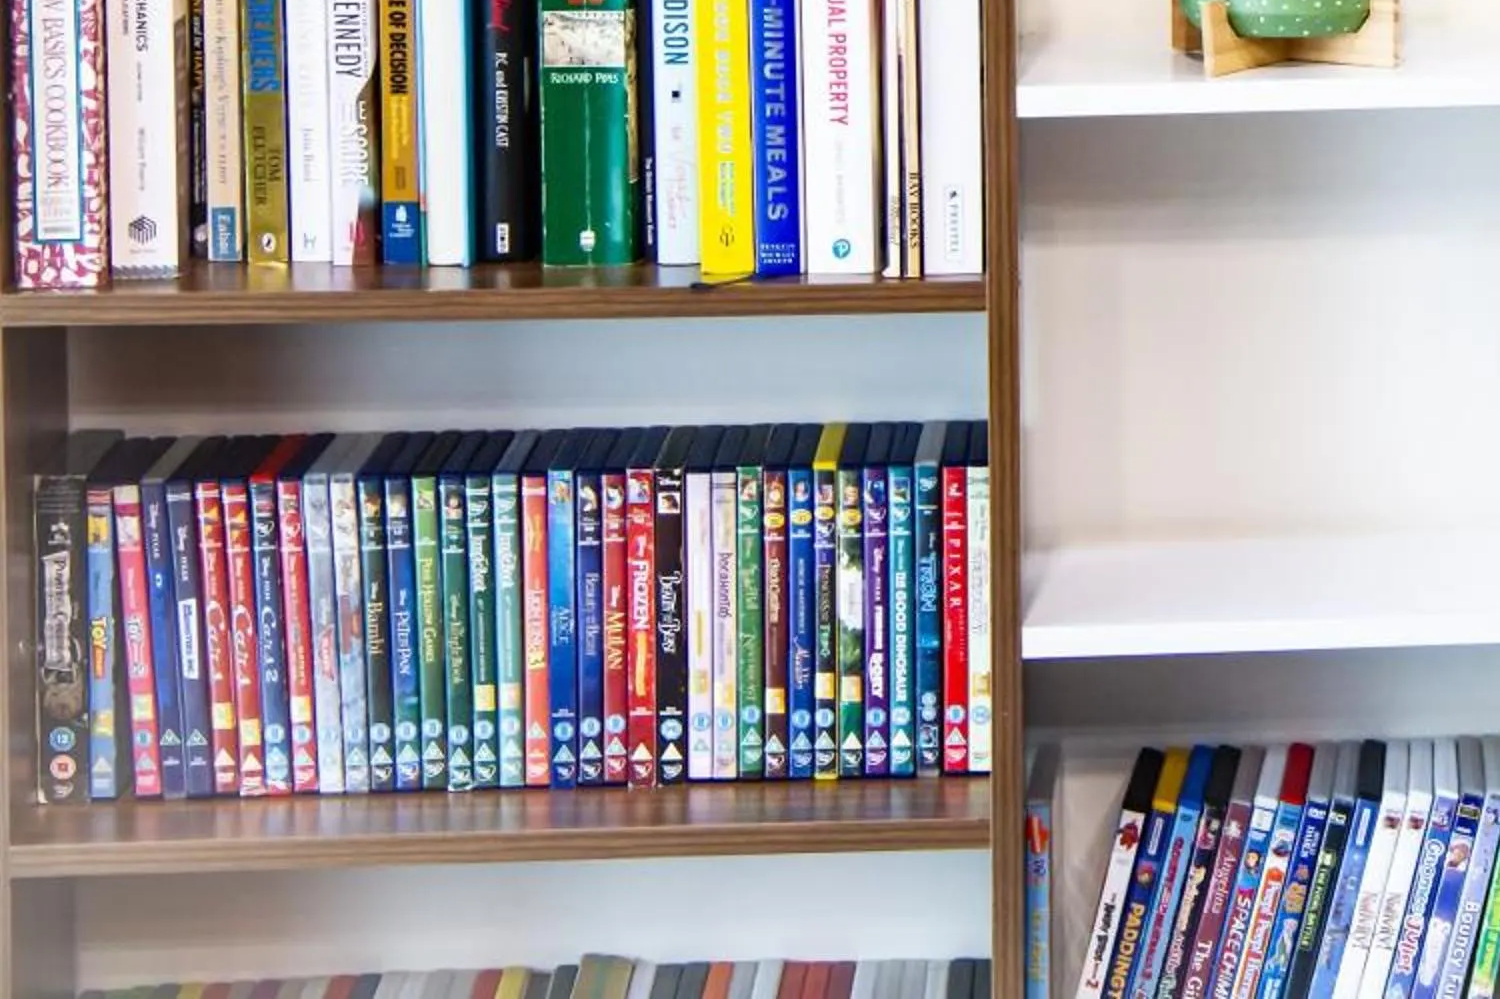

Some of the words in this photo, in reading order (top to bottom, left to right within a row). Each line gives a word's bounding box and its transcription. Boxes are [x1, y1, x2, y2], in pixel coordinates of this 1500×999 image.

[43, 17, 67, 80] BASICS
[388, 11, 408, 29] OF
[389, 32, 409, 95] DECISION
[495, 70, 509, 88] and
[550, 71, 593, 85] RICHARD
[714, 49, 732, 101] BOOK
[827, 33, 849, 126] PROPERTY
[44, 83, 71, 190] COOKBOOK
[251, 125, 268, 206] FLETCHER
[266, 147, 281, 182] TOM
[339, 123, 369, 186] SCORE
[495, 124, 510, 149] CAST
[764, 124, 789, 222] MEALS
[631, 559, 650, 630] FROZEN
[716, 551, 734, 619] POCAHONTAS
[948, 538, 963, 609] PIXAR
[91, 616, 108, 649] TOY
[260, 604, 277, 667] Cars
[367, 601, 384, 655] Bambi
[395, 610, 411, 648] PETER
[895, 589, 907, 632] GOOD
[207, 601, 226, 682] Cars
[231, 604, 253, 687] Cars
[396, 648, 412, 676] PAN
[423, 626, 437, 663] GAMES
[606, 610, 626, 670] MULAN
[895, 633, 907, 702] DINOSAUR
[264, 668, 279, 683] 2
[868, 651, 884, 699] DORY
[1226, 894, 1251, 951] SPACE
[1450, 899, 1480, 971] Bouncy
[1194, 940, 1213, 972] The
